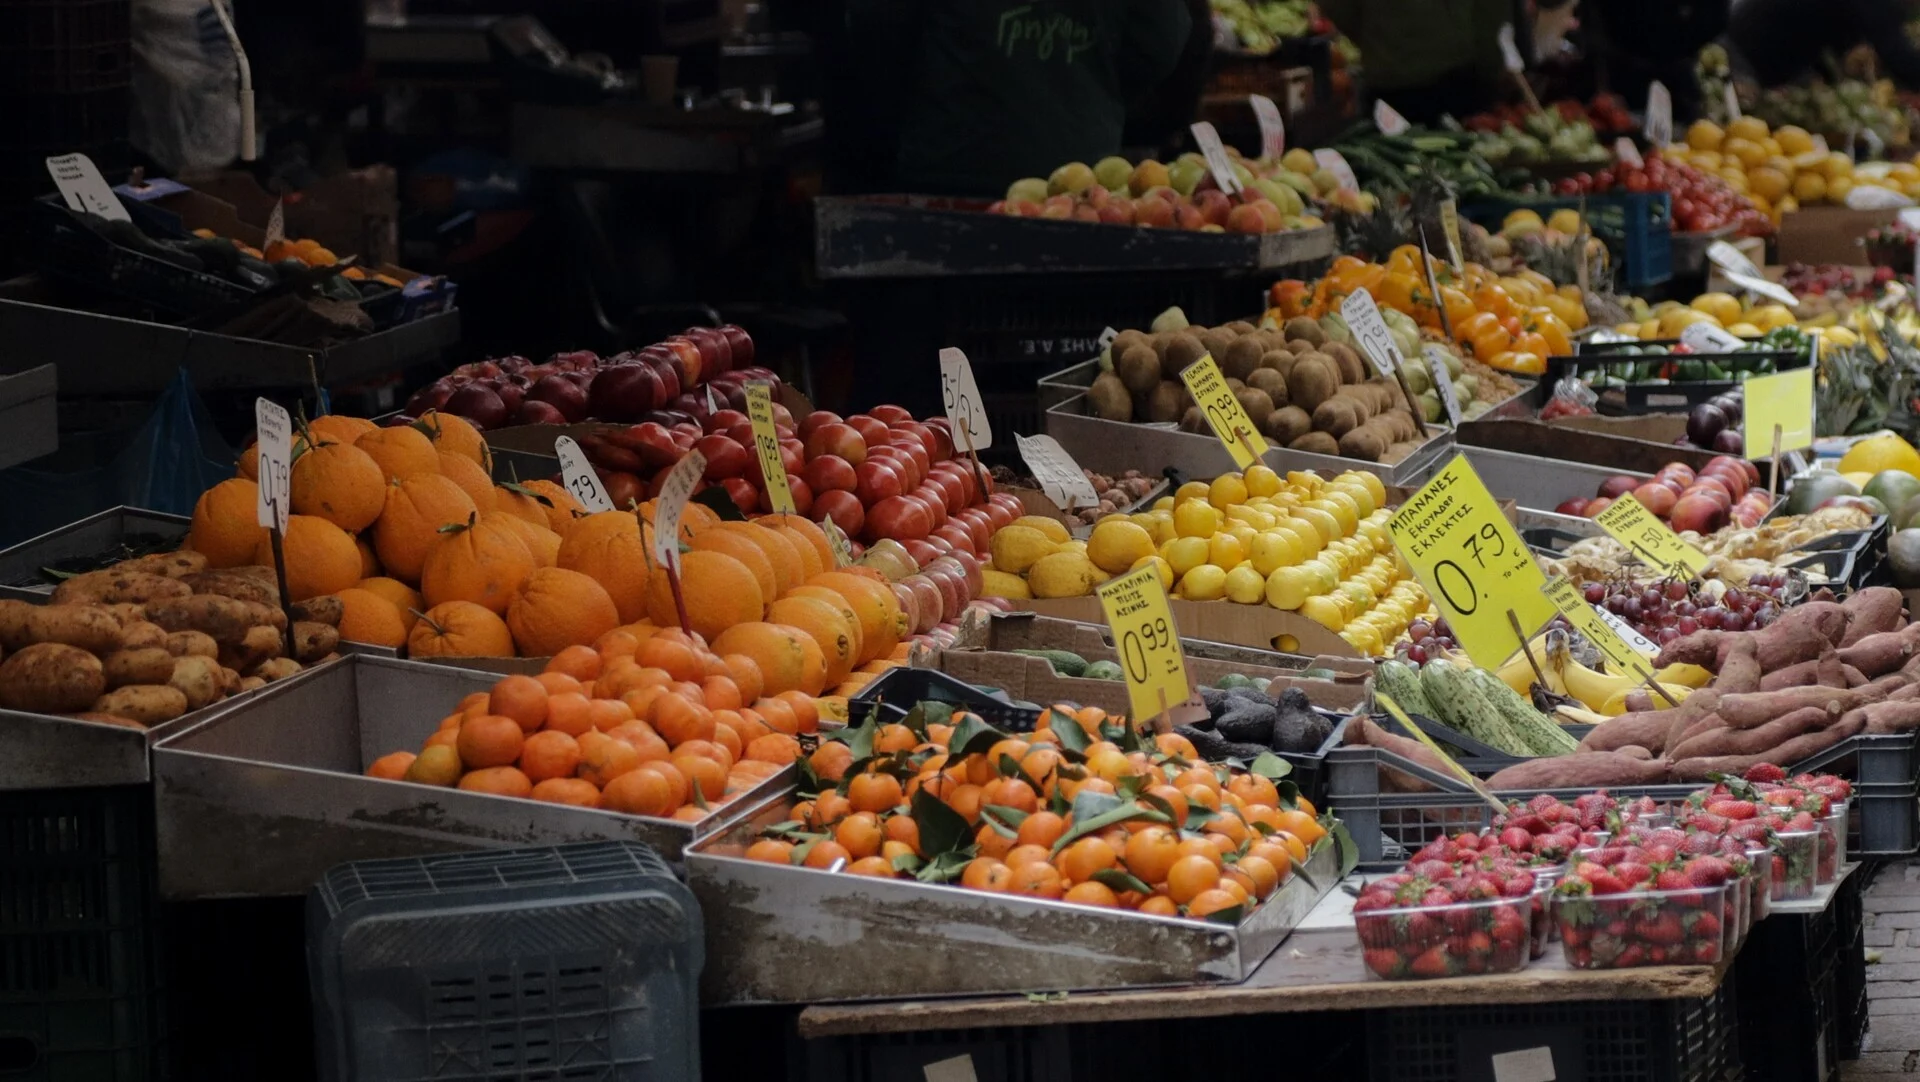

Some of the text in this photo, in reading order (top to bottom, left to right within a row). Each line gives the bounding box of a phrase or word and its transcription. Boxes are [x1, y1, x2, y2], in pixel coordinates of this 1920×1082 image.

[1389, 471, 1459, 536] ΜΠΑΝΑΝΕΣ
[1410, 503, 1474, 558] ΕΚΛΕΚΤΕΣ
[1101, 571, 1155, 599] ΜΑΝΤΑΡΙΝΙΑ
